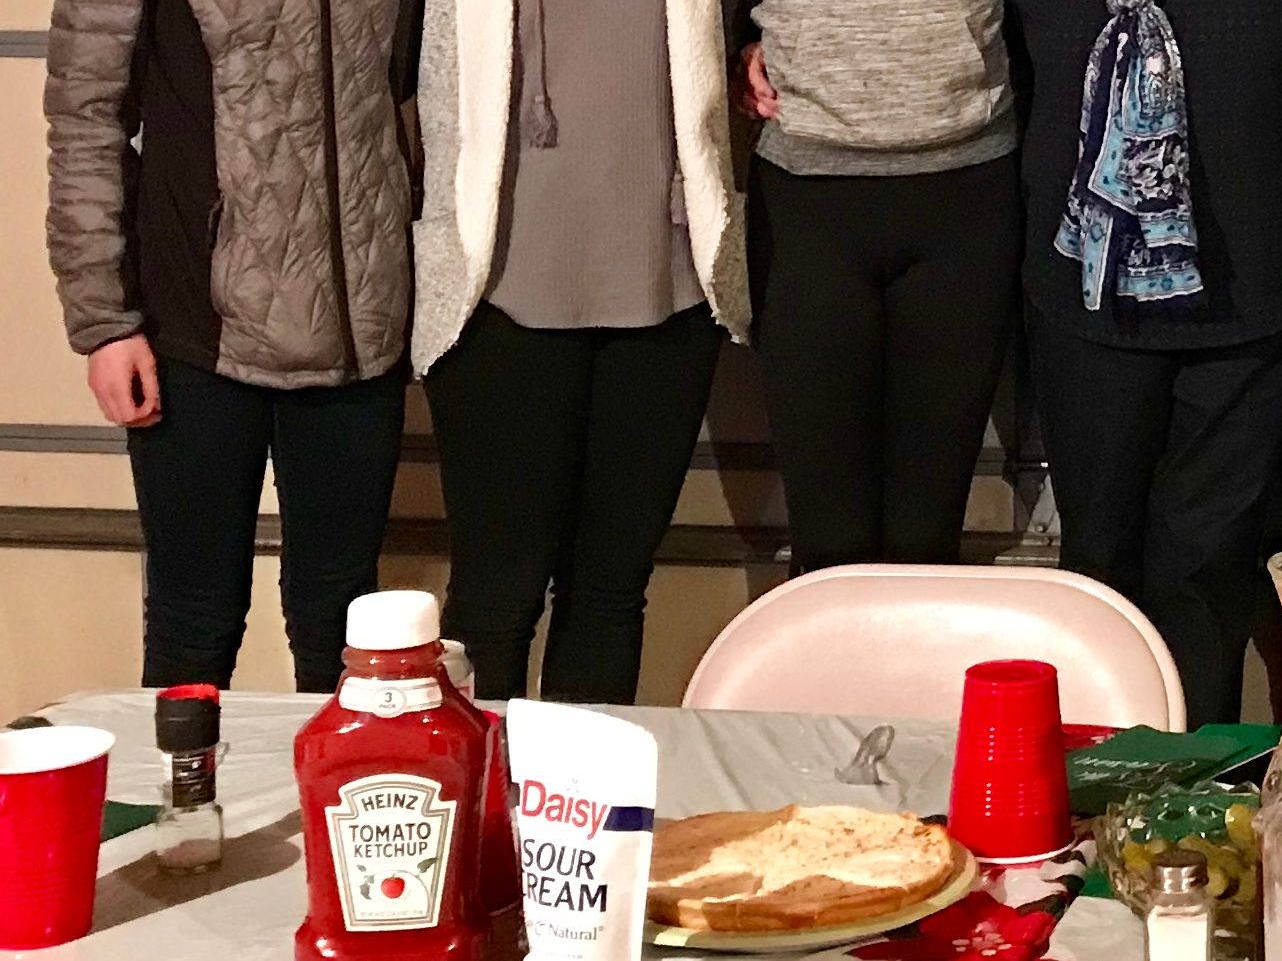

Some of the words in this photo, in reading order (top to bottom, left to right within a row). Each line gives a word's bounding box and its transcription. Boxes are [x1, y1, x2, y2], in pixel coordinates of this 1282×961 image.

[384, 692, 393, 703] 3
[361, 793, 419, 812] HEINZ
[521, 779, 608, 840] Daisy
[349, 822, 431, 842] TOMATO
[354, 841, 428, 858] KETCHUP
[523, 839, 596, 880] SOUR
[523, 870, 608, 912] REAM
